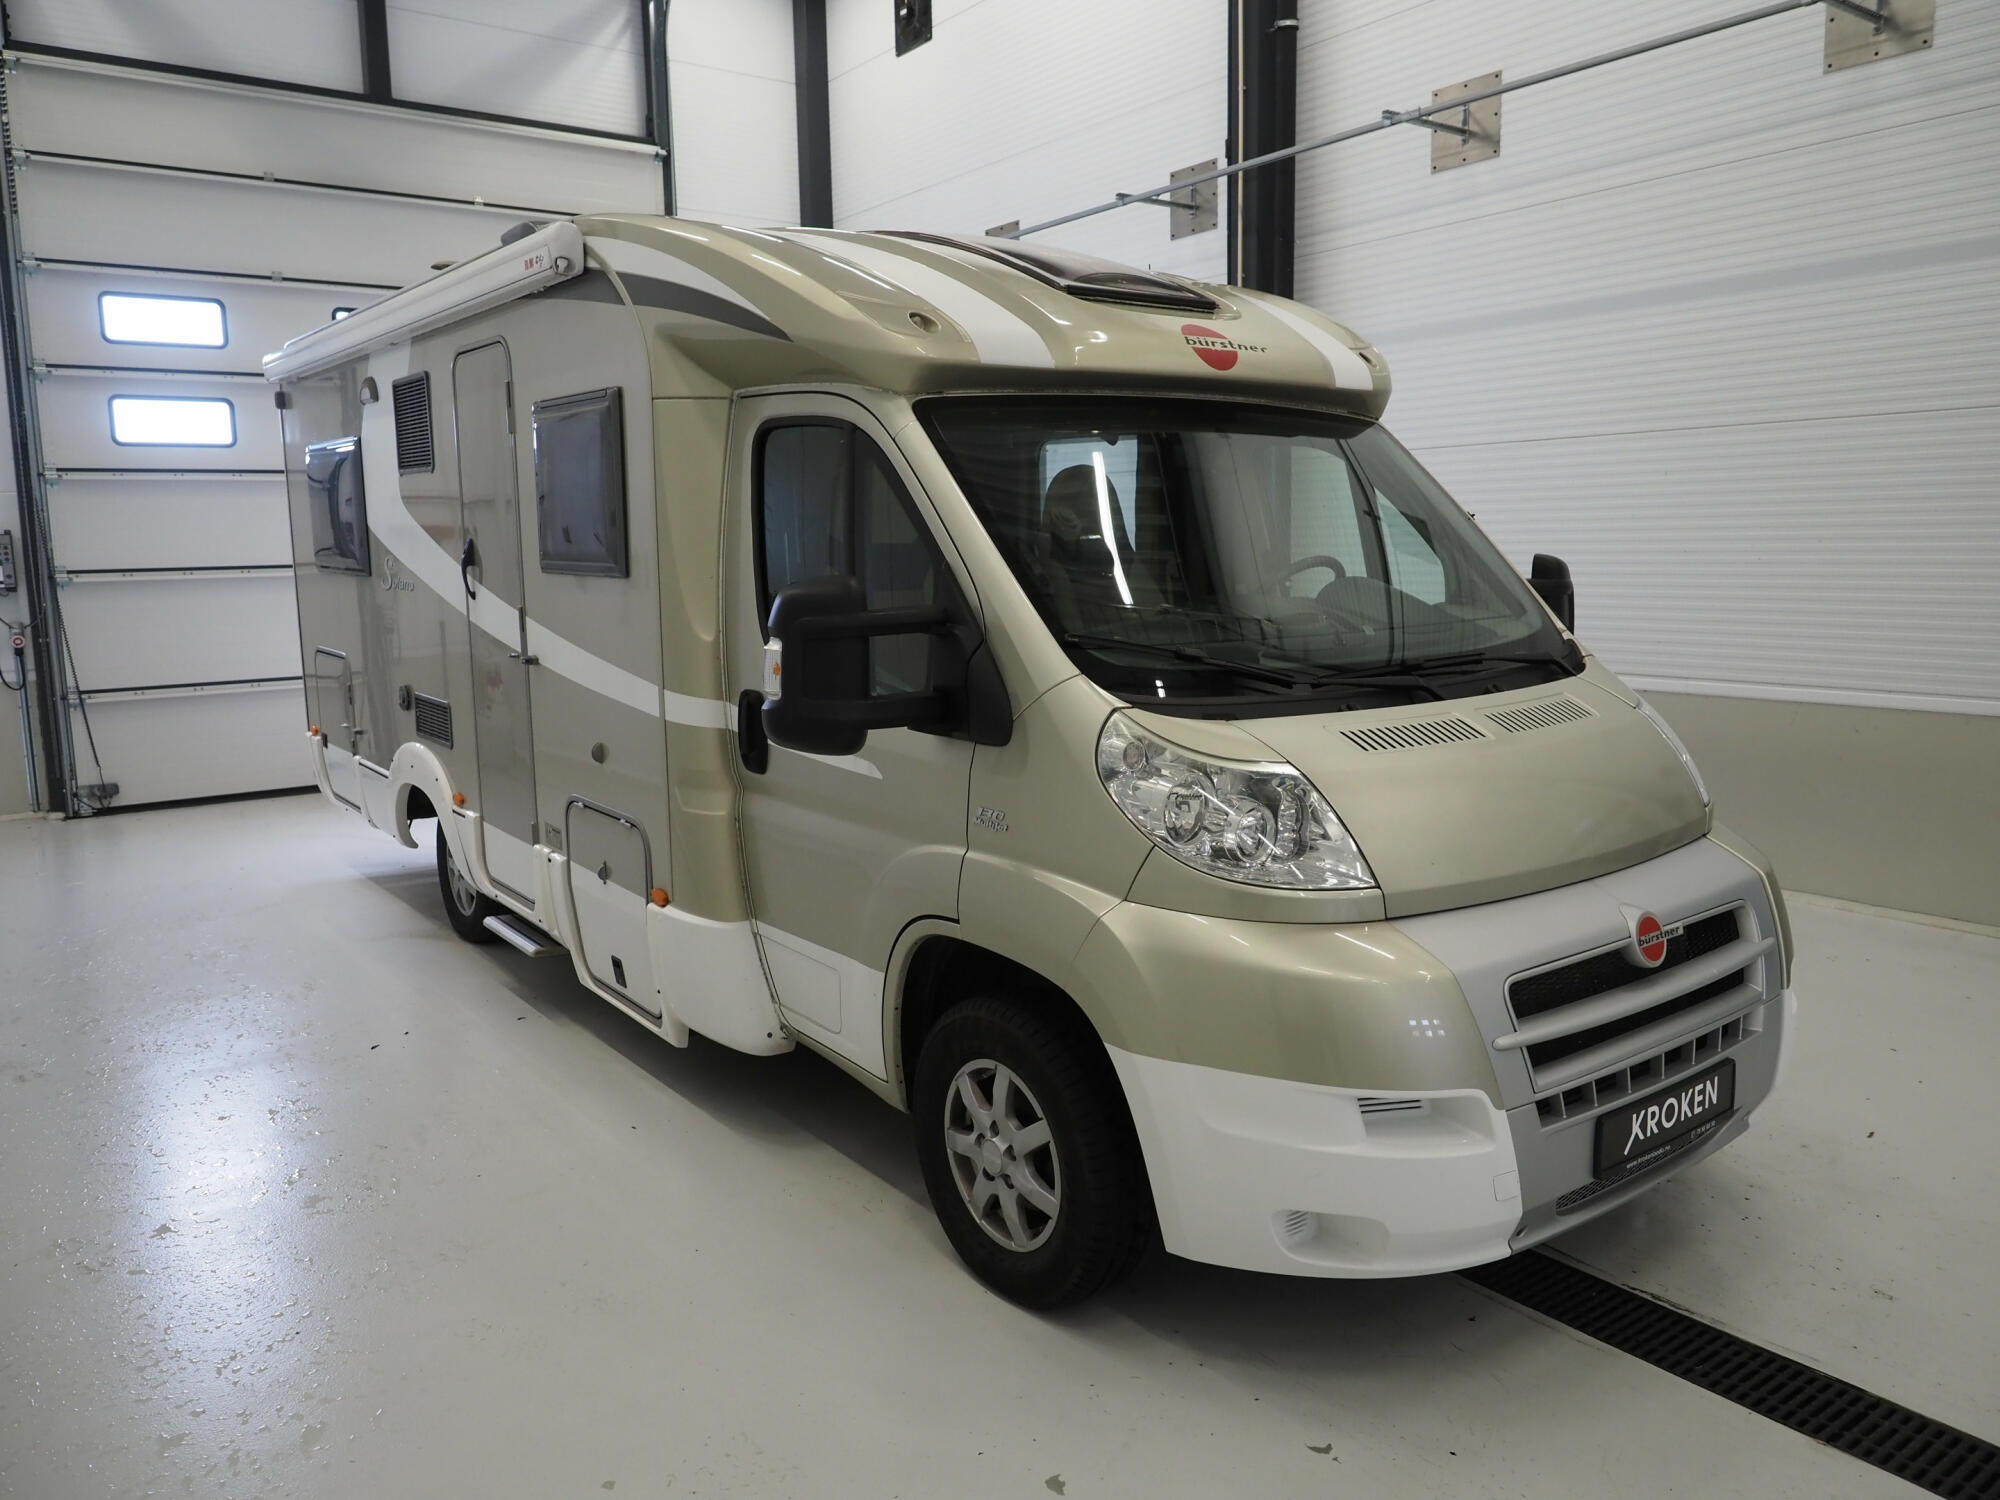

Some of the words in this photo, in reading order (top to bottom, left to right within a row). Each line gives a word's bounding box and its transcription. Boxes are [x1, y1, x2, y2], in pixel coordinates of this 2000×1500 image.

[1184, 336, 1268, 353] bürstner
[1638, 926, 1680, 947] bürstner
[1623, 1075, 1718, 1156] KROKEN
